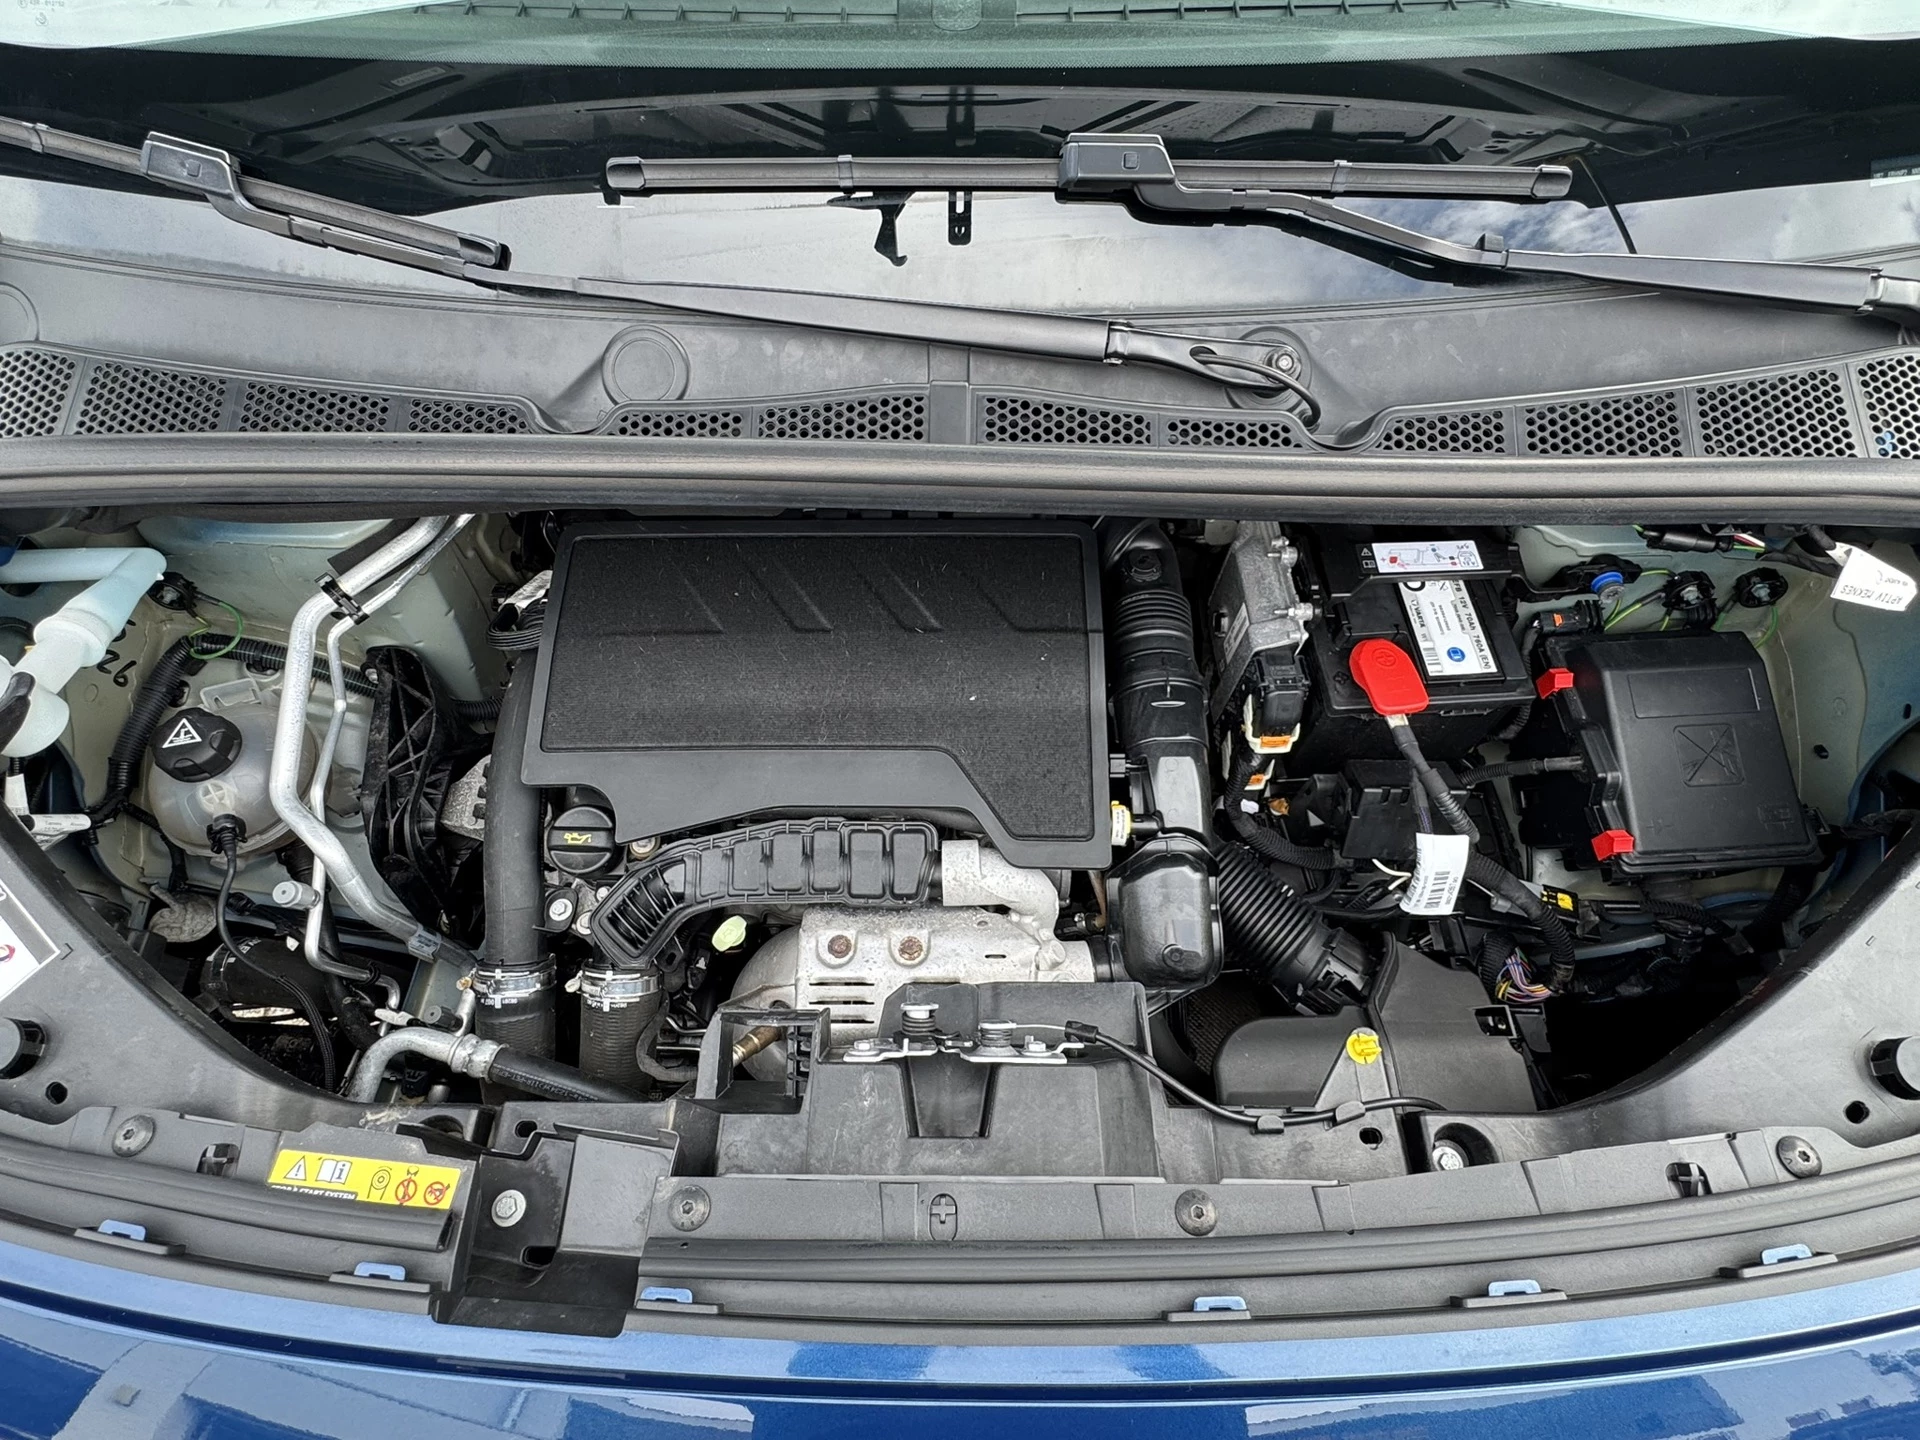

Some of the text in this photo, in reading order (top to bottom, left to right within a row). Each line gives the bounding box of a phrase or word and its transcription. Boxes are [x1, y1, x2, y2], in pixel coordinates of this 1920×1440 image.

[1414, 606, 1426, 628] VARTA
[1459, 596, 1469, 610] 12V
[1465, 612, 1477, 631] 70Ah
